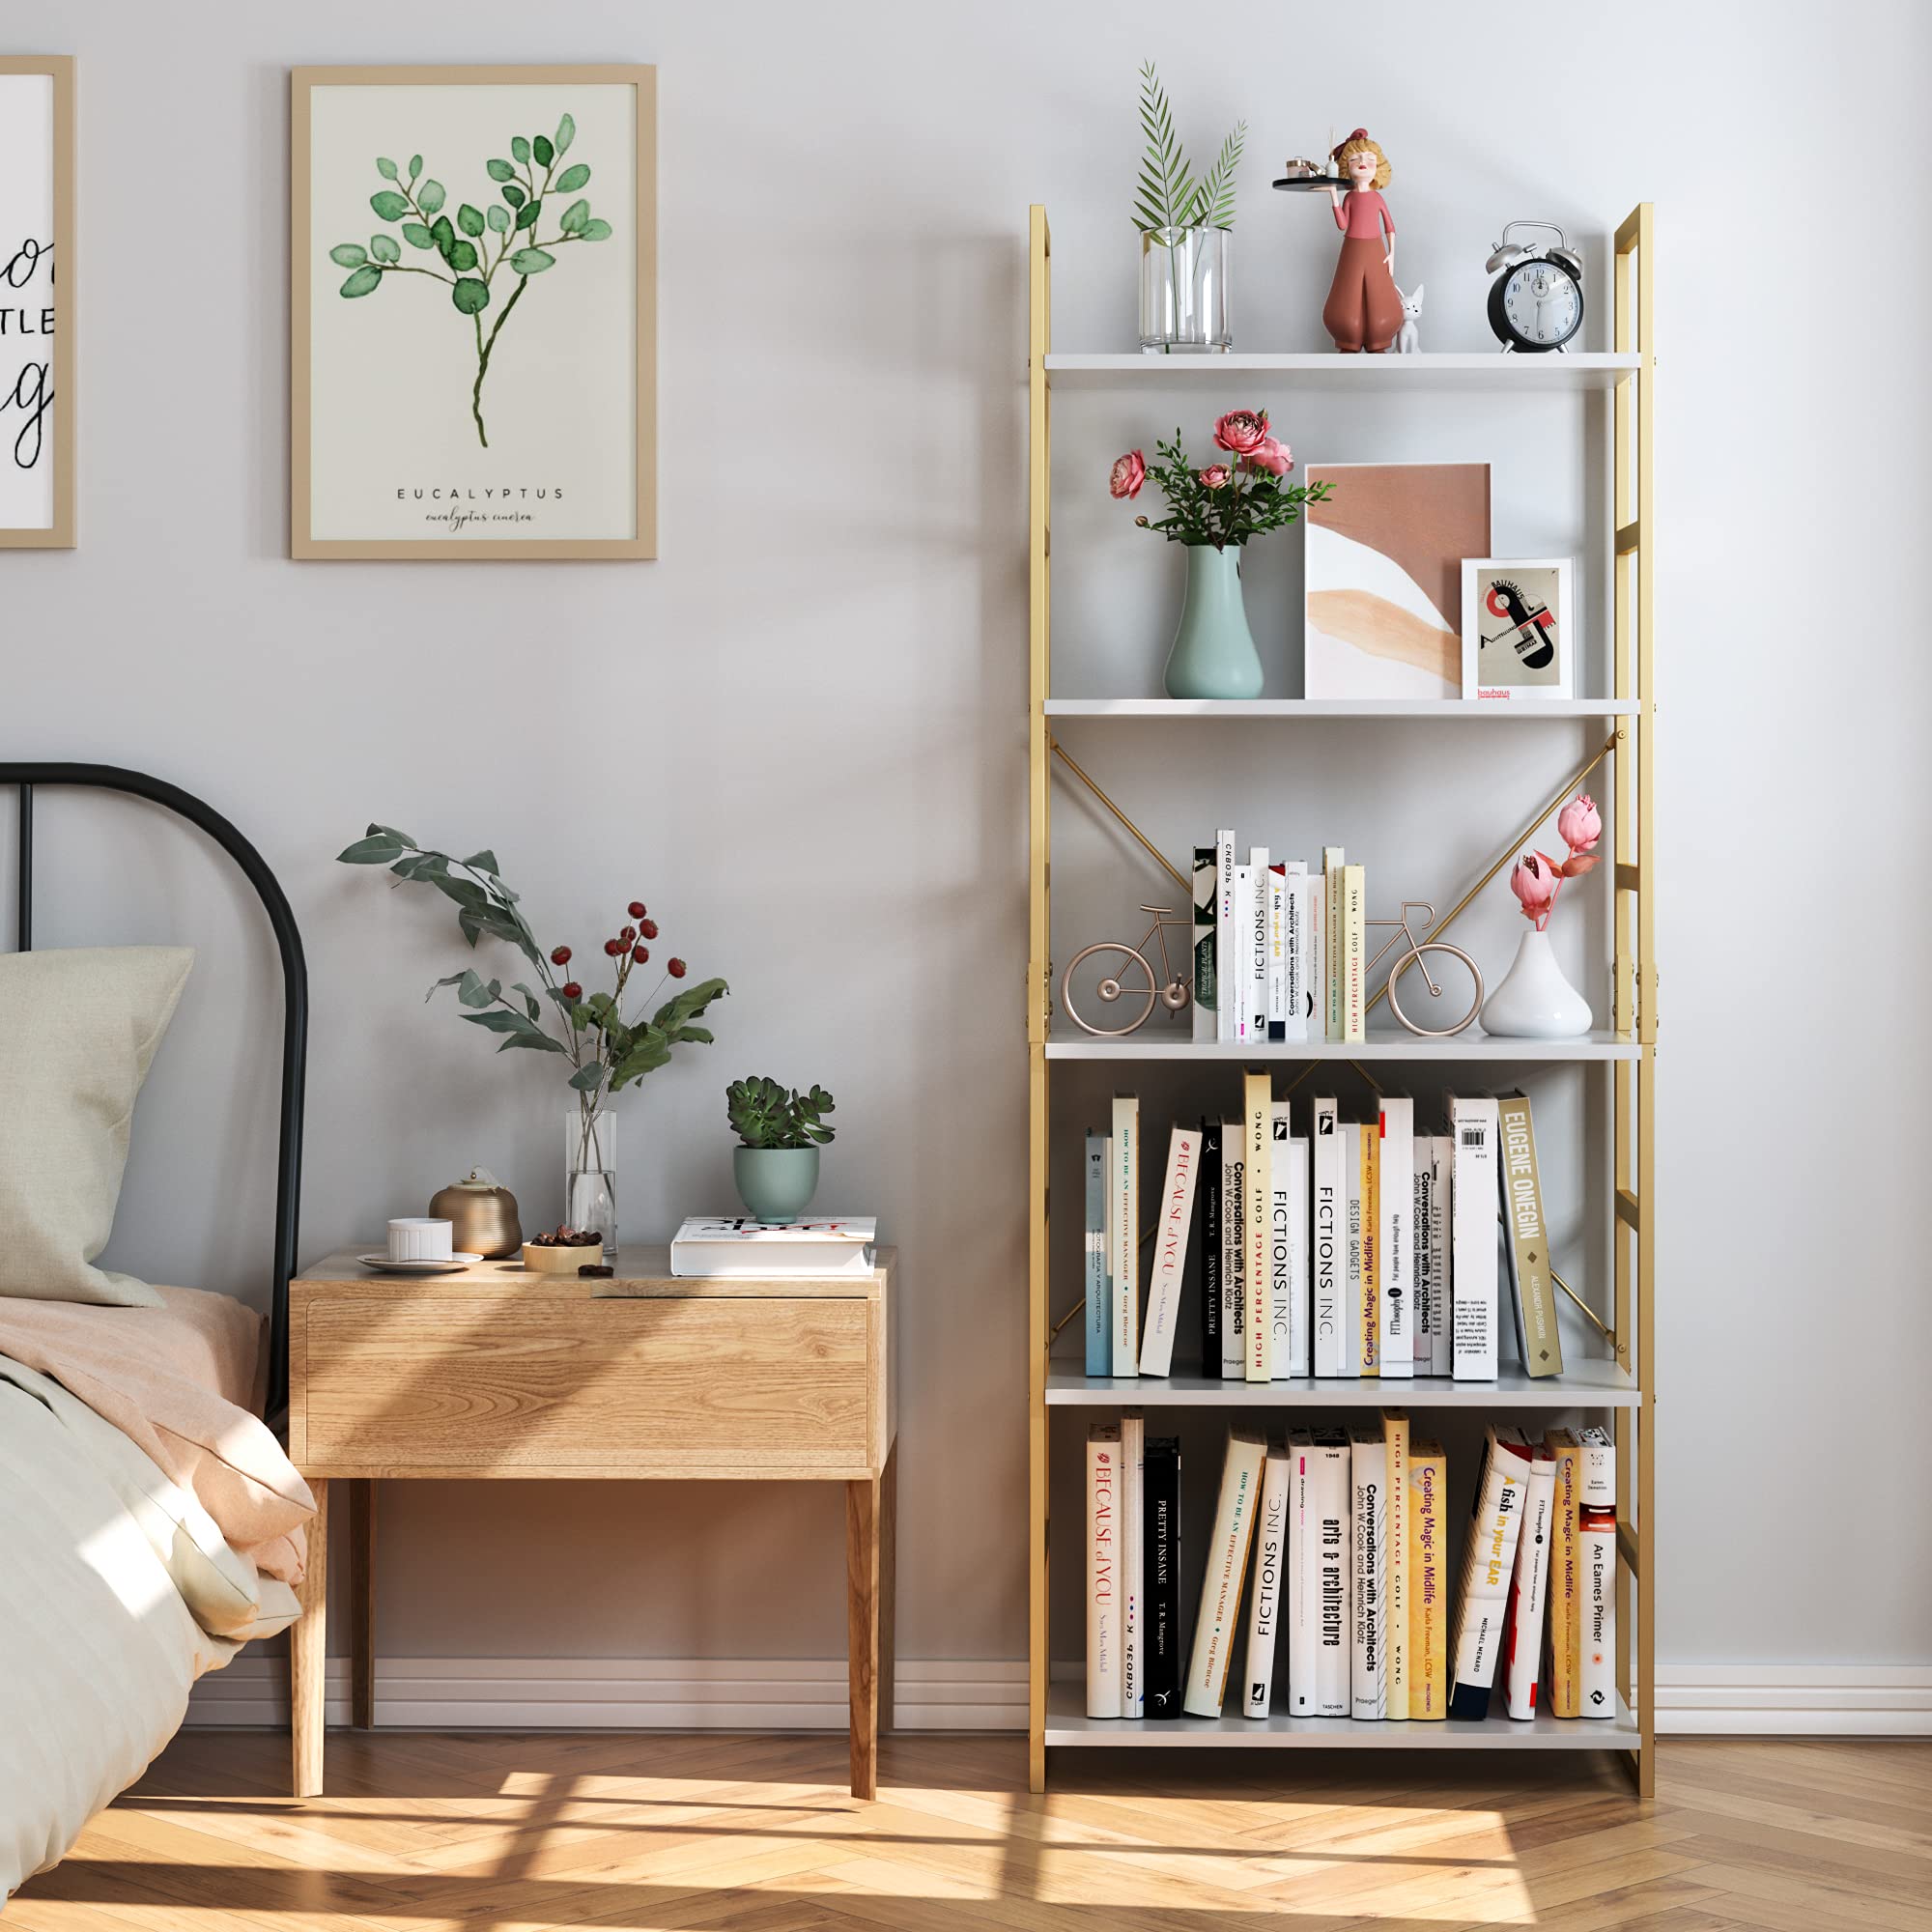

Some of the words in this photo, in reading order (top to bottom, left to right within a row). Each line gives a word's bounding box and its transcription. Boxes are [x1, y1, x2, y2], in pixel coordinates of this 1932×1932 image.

[1513, 283, 1520, 294] 10
[1523, 272, 1530, 282] 11
[1536, 270, 1545, 279] 12
[1553, 273, 1556, 282] 1
[1507, 298, 1513, 307] 9
[1512, 314, 1518, 323] 8
[1554, 327, 1560, 336] 5
[1538, 330, 1544, 340] 6
[398, 489, 561, 498] EUCALYPTUS
[425, 505, 487, 532] eucalyptus
[493, 513, 530, 522] cinerea
[1492, 580, 1525, 600] BAUHAUS
[1255, 873, 1264, 905] INC.
[1255, 910, 1264, 979] FICTIONS
[1123, 1151, 1129, 1162] TO
[1504, 1111, 1533, 1176] EUGENE
[1123, 1166, 1129, 1175] BE
[1123, 1180, 1129, 1189] AN
[1224, 1162, 1233, 1186] John
[1170, 1152, 1189, 1226] BECAUSE
[1234, 1161, 1244, 1246] Conversations
[1350, 1199, 1360, 1235] DESIGN
[1421, 1171, 1431, 1251] Conversations
[1513, 1179, 1540, 1239] ONEGIN
[1224, 1226, 1233, 1245] and
[1274, 1192, 1287, 1290] FICTIONS
[1320, 1188, 1332, 1288] FICTIONS
[1392, 1225, 1401, 1243] enough
[1163, 1235, 1178, 1274] YOU
[1224, 1247, 1233, 1282] Heinrich
[1234, 1247, 1244, 1273] with
[1350, 1239, 1360, 1280] GADGETS
[1362, 1236, 1373, 1271] Midlife
[1392, 1256, 1401, 1272] people
[1421, 1252, 1431, 1277] with
[1365, 1275, 1373, 1284] in
[1530, 1274, 1542, 1307] ALEXANDR
[1224, 1283, 1233, 1310] Klotz
[1234, 1276, 1244, 1335] Architects
[1364, 1288, 1376, 1318] Magic
[1421, 1278, 1431, 1334] Architects
[1274, 1300, 1287, 1340] INC.
[1320, 1299, 1332, 1340] INC.
[1532, 1306, 1547, 1340] PUSHKIN
[1363, 1321, 1376, 1366] Creating
[1222, 1357, 1245, 1366] Praeger
[1240, 1471, 1249, 1491] HOW
[1420, 1467, 1435, 1514] Creating
[1503, 1476, 1516, 1487] A
[1562, 1457, 1574, 1508] Creating
[1095, 1467, 1112, 1547] BECAUSE
[1236, 1492, 1245, 1506] TO
[1356, 1485, 1365, 1511] John
[1497, 1487, 1516, 1514] fish
[1231, 1520, 1239, 1533] AN
[1235, 1506, 1242, 1519] BE
[1267, 1494, 1281, 1532] INC.
[1496, 1513, 1510, 1528] in
[1562, 1508, 1574, 1544] Magic
[1323, 1520, 1340, 1544] arts
[1366, 1483, 1378, 1576] Conversations
[1420, 1518, 1435, 1548] Magic
[1490, 1528, 1506, 1559] your
[1095, 1551, 1111, 1562] of
[1223, 1534, 1237, 1579] EFFECTIVE
[1356, 1553, 1365, 1576] and
[1425, 1553, 1435, 1562] in
[1563, 1545, 1574, 1557] in
[1594, 1545, 1603, 1559] An
[1096, 1567, 1111, 1605] YOU
[1424, 1567, 1435, 1604] Midlife
[1485, 1560, 1501, 1585] EAR
[1563, 1559, 1574, 1600] Midlife
[1594, 1564, 1603, 1601] Eames
[1215, 1580, 1230, 1622] MANAGER
[1258, 1541, 1277, 1635] FICTIONS
[1356, 1577, 1365, 1619] Heinrich
[1366, 1577, 1378, 1605] with
[1158, 1602, 1166, 1610] T.
[1158, 1612, 1166, 1622] R.
[1323, 1568, 1344, 1645] architecture
[1356, 1620, 1365, 1645] Klotz
[1479, 1618, 1488, 1648] MICHAEL
[1594, 1605, 1604, 1642] Primer
[1208, 1635, 1219, 1656] Greg
[1366, 1607, 1378, 1672] Architects
[1204, 1657, 1215, 1689] Blencoe
[1355, 1696, 1378, 1706] Praeger
